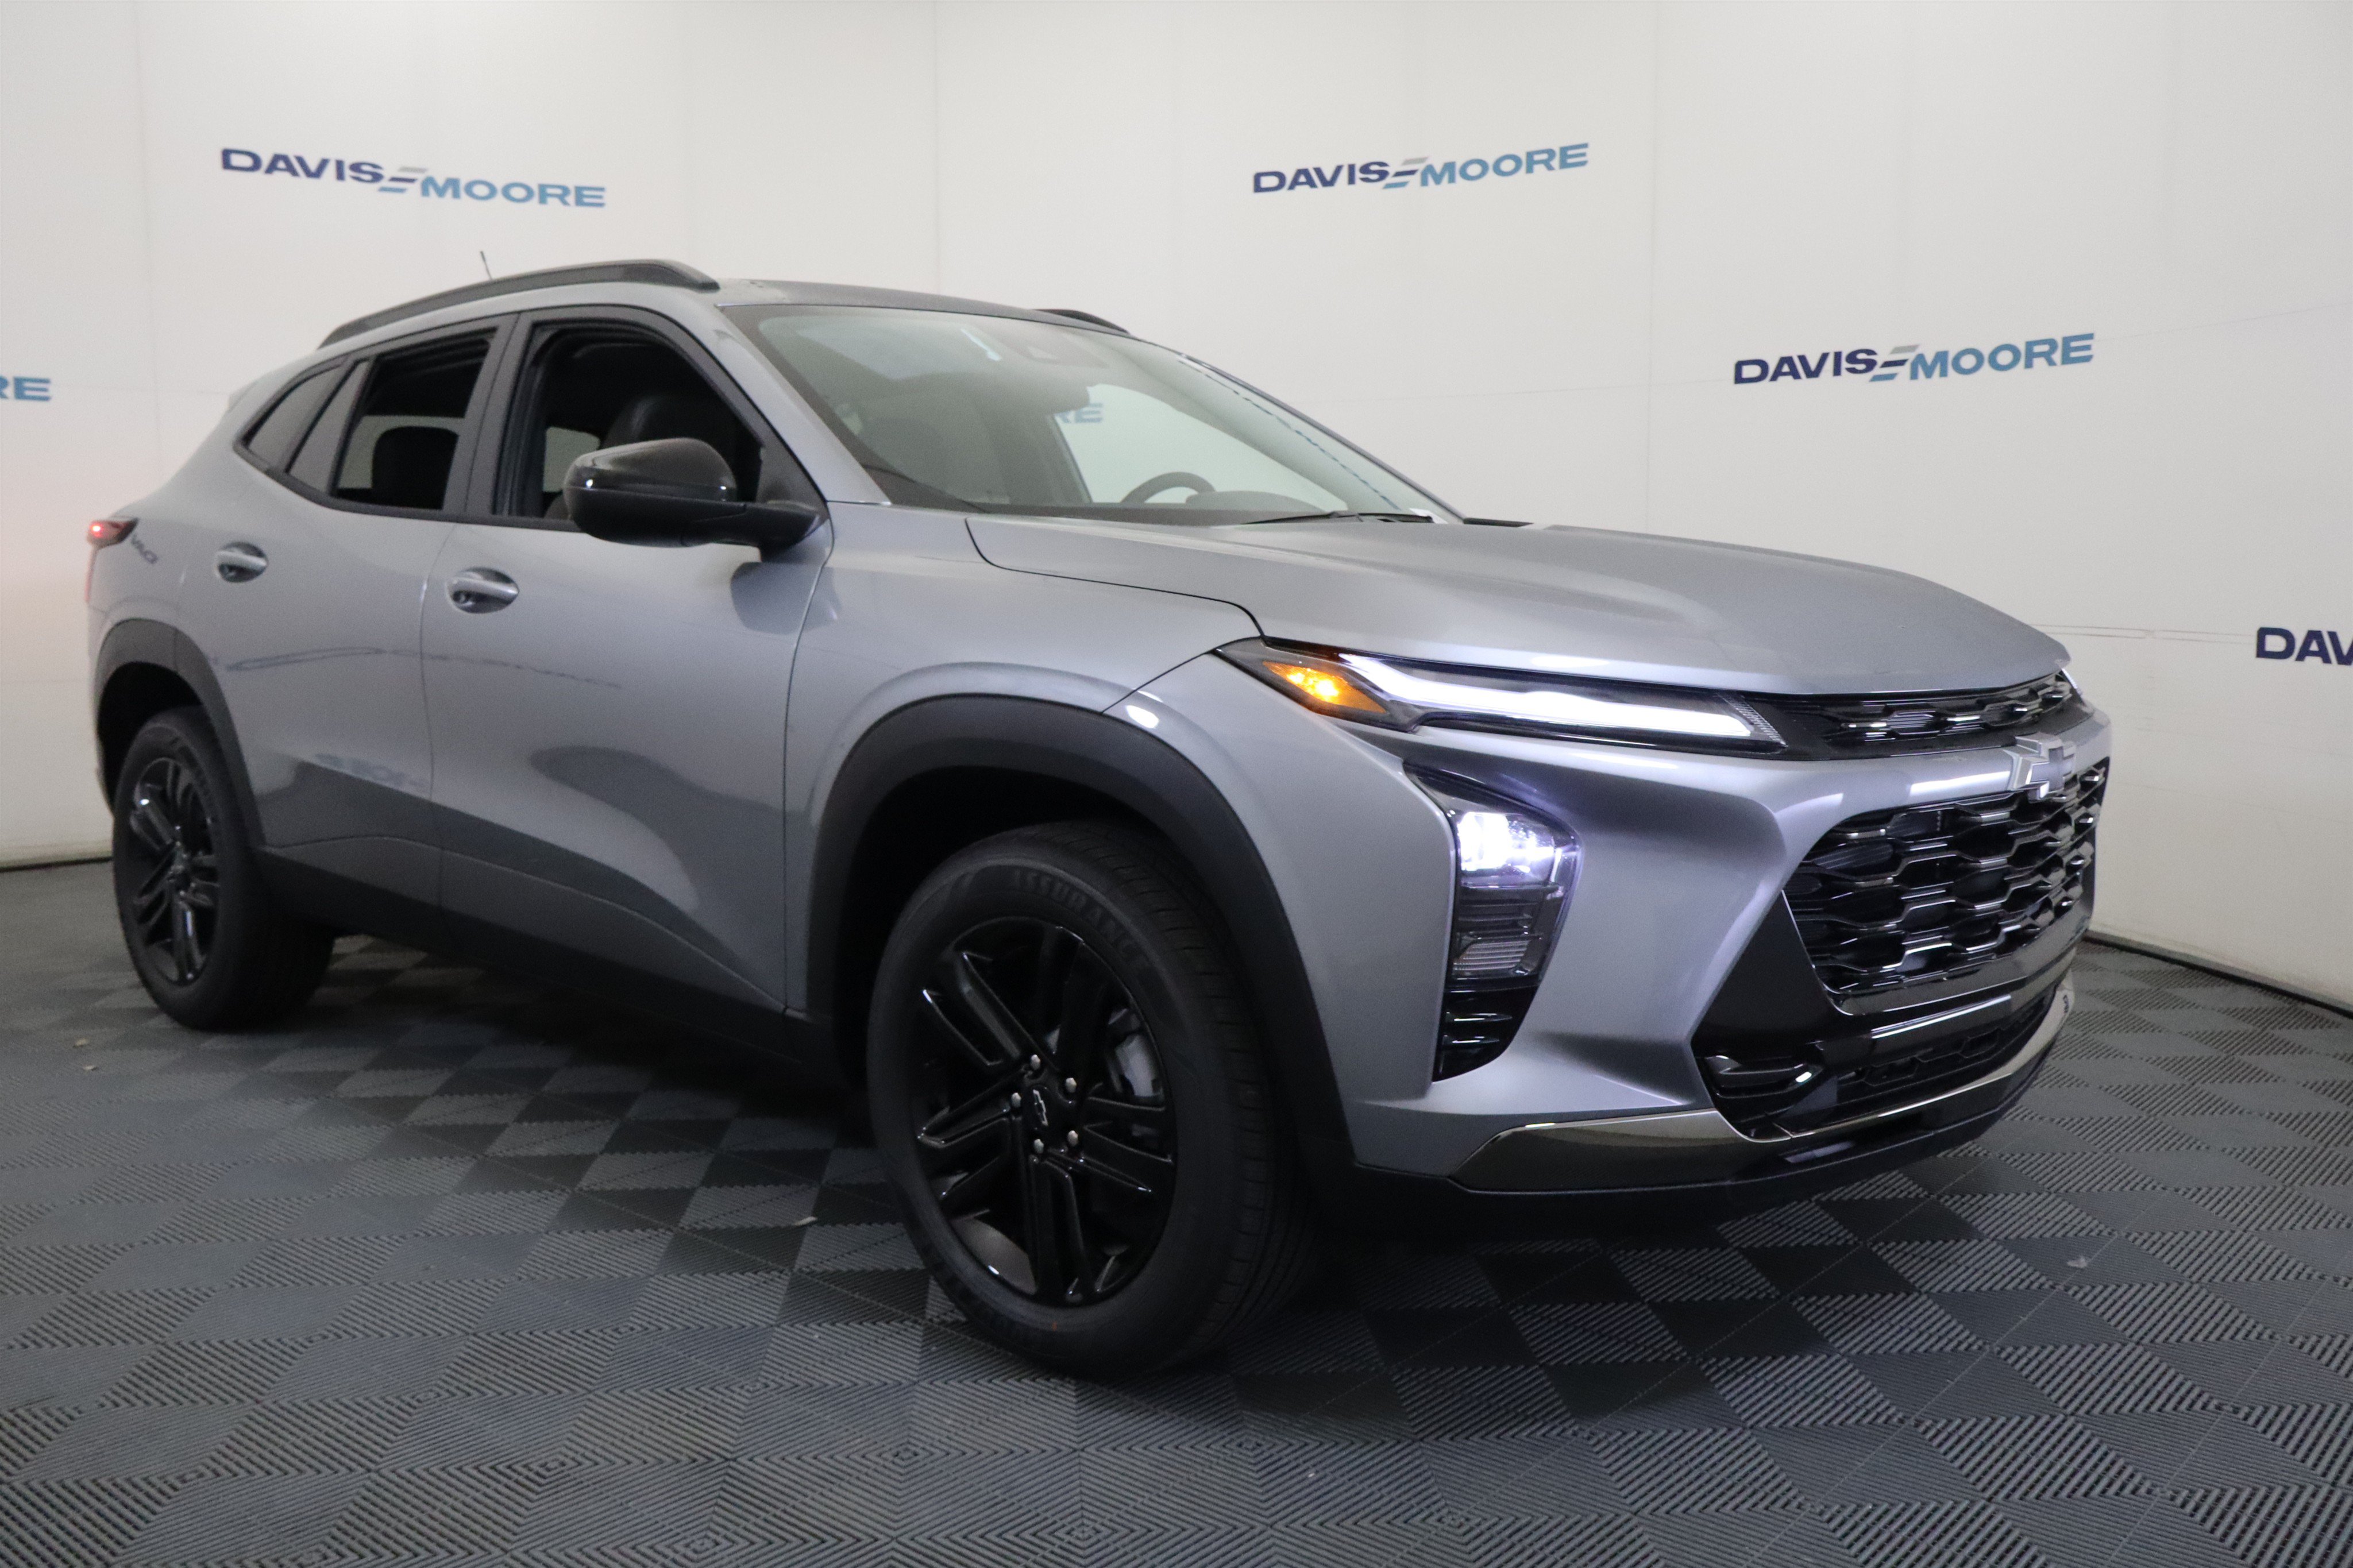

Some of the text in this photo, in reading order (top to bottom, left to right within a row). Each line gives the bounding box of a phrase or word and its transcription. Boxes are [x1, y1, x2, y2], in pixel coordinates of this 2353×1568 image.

[221, 148, 605, 207] DAVIS MOORE
[1253, 143, 1589, 193] DAVIS MOORE
[1733, 333, 2094, 384] DAVIS MOORE
